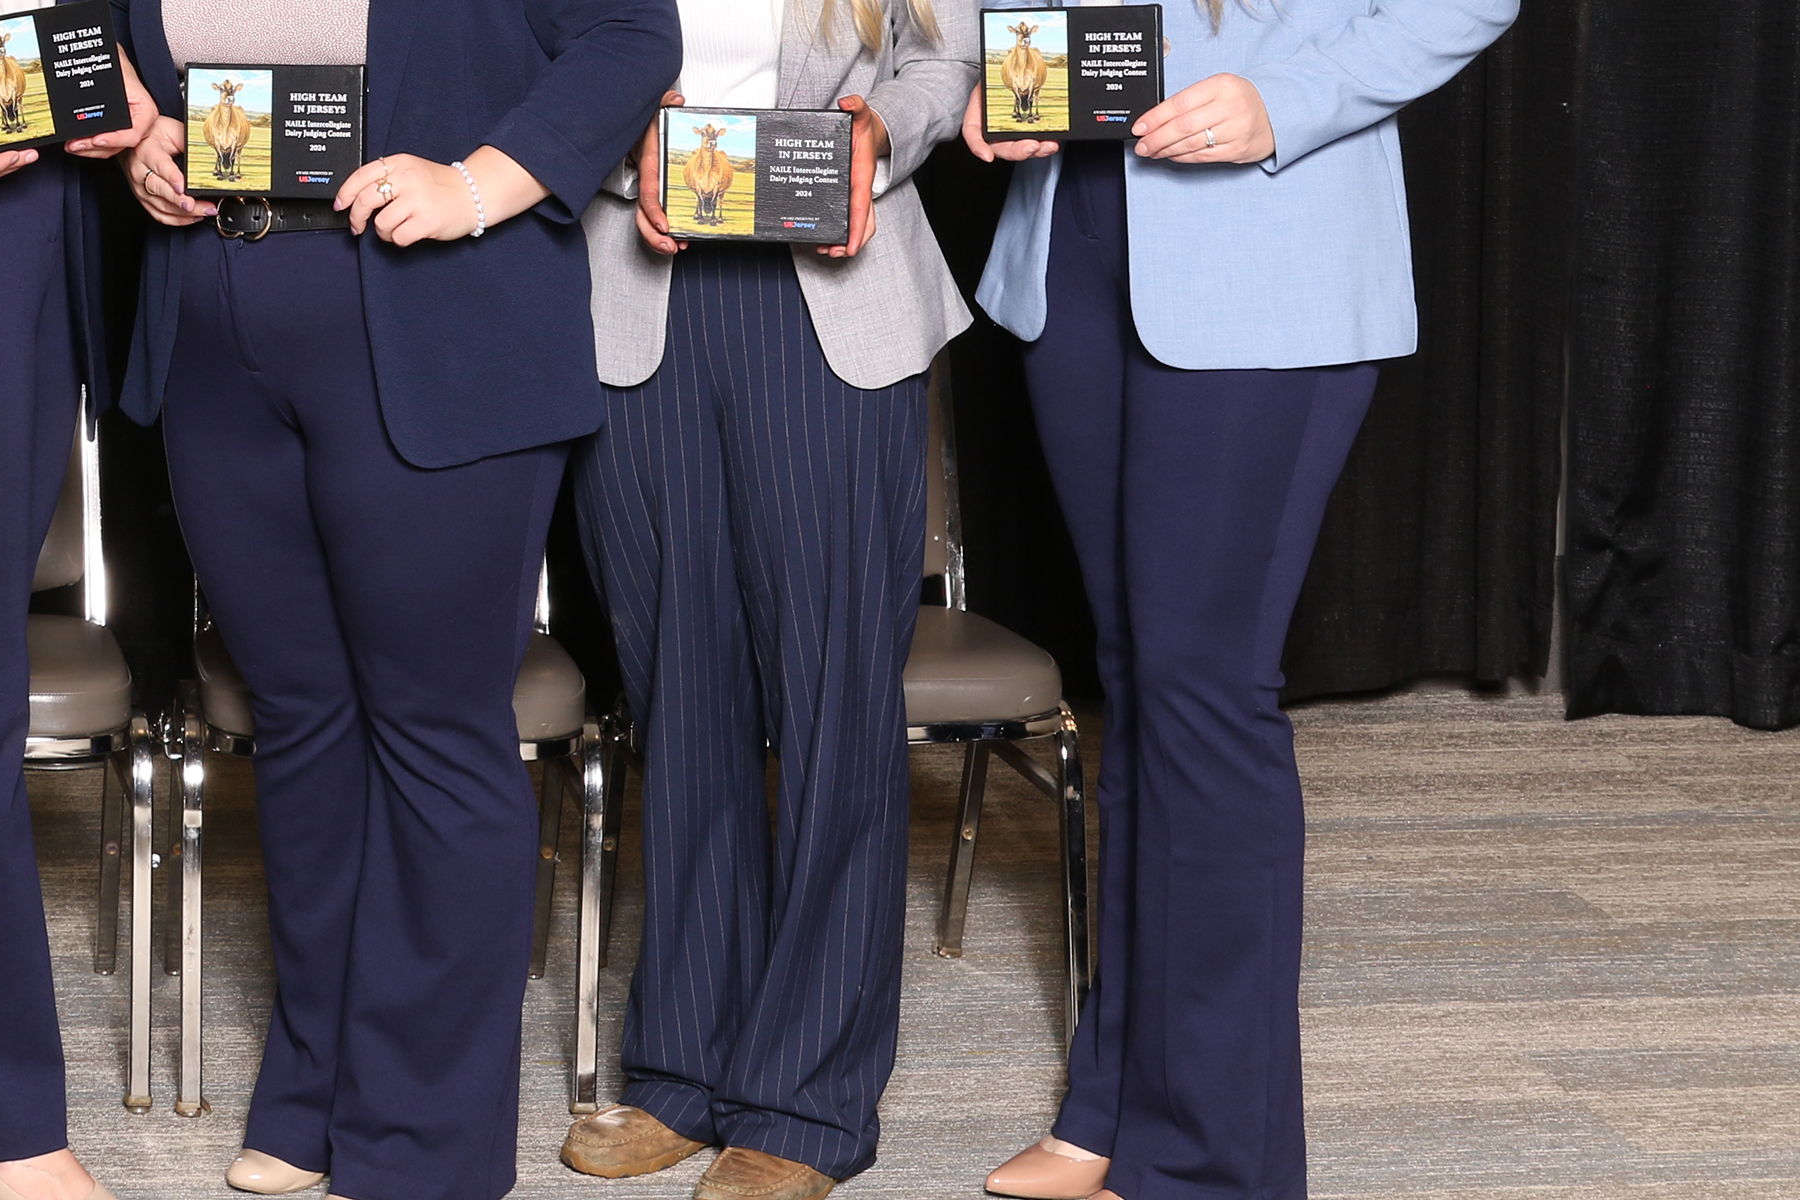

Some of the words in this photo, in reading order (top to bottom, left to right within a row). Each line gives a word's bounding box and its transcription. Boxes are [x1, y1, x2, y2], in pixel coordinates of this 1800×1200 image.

[52, 33, 76, 42] HIGH
[77, 26, 102, 38] TEAM
[1085, 33, 1111, 41] HIGH
[1113, 32, 1142, 41] TEAM
[58, 44, 68, 53] IN
[70, 38, 103, 53] JERSEYS
[1089, 45, 1100, 53] IN
[1102, 44, 1141, 54] JERSEYS
[54, 59, 72, 68] NAILE
[73, 54, 110, 66] Intercollegiate
[1103, 60, 1147, 68] Intercollegiate
[56, 70, 70, 78] Dairy
[72, 66, 92, 76] Judging
[92, 62, 112, 72] Contest
[1082, 69, 1098, 77] Dairy
[1100, 69, 1123, 77] Judging
[80, 80, 94, 88] 2024
[290, 93, 316, 102] HIGH
[318, 94, 347, 102] TEAM
[294, 105, 305, 113] IN
[307, 105, 346, 114] JERSEYS
[308, 121, 351, 129] Intercollegiate
[285, 130, 302, 138] Dairy
[303, 130, 326, 138] Judging
[775, 139, 802, 147] HIGH
[804, 140, 834, 148] TEAM
[779, 151, 790, 159] IN
[792, 151, 833, 160] JERSEYS
[793, 167, 838, 175] Intercollegiate
[770, 175, 787, 183] Dairy
[789, 176, 813, 184] Judging
